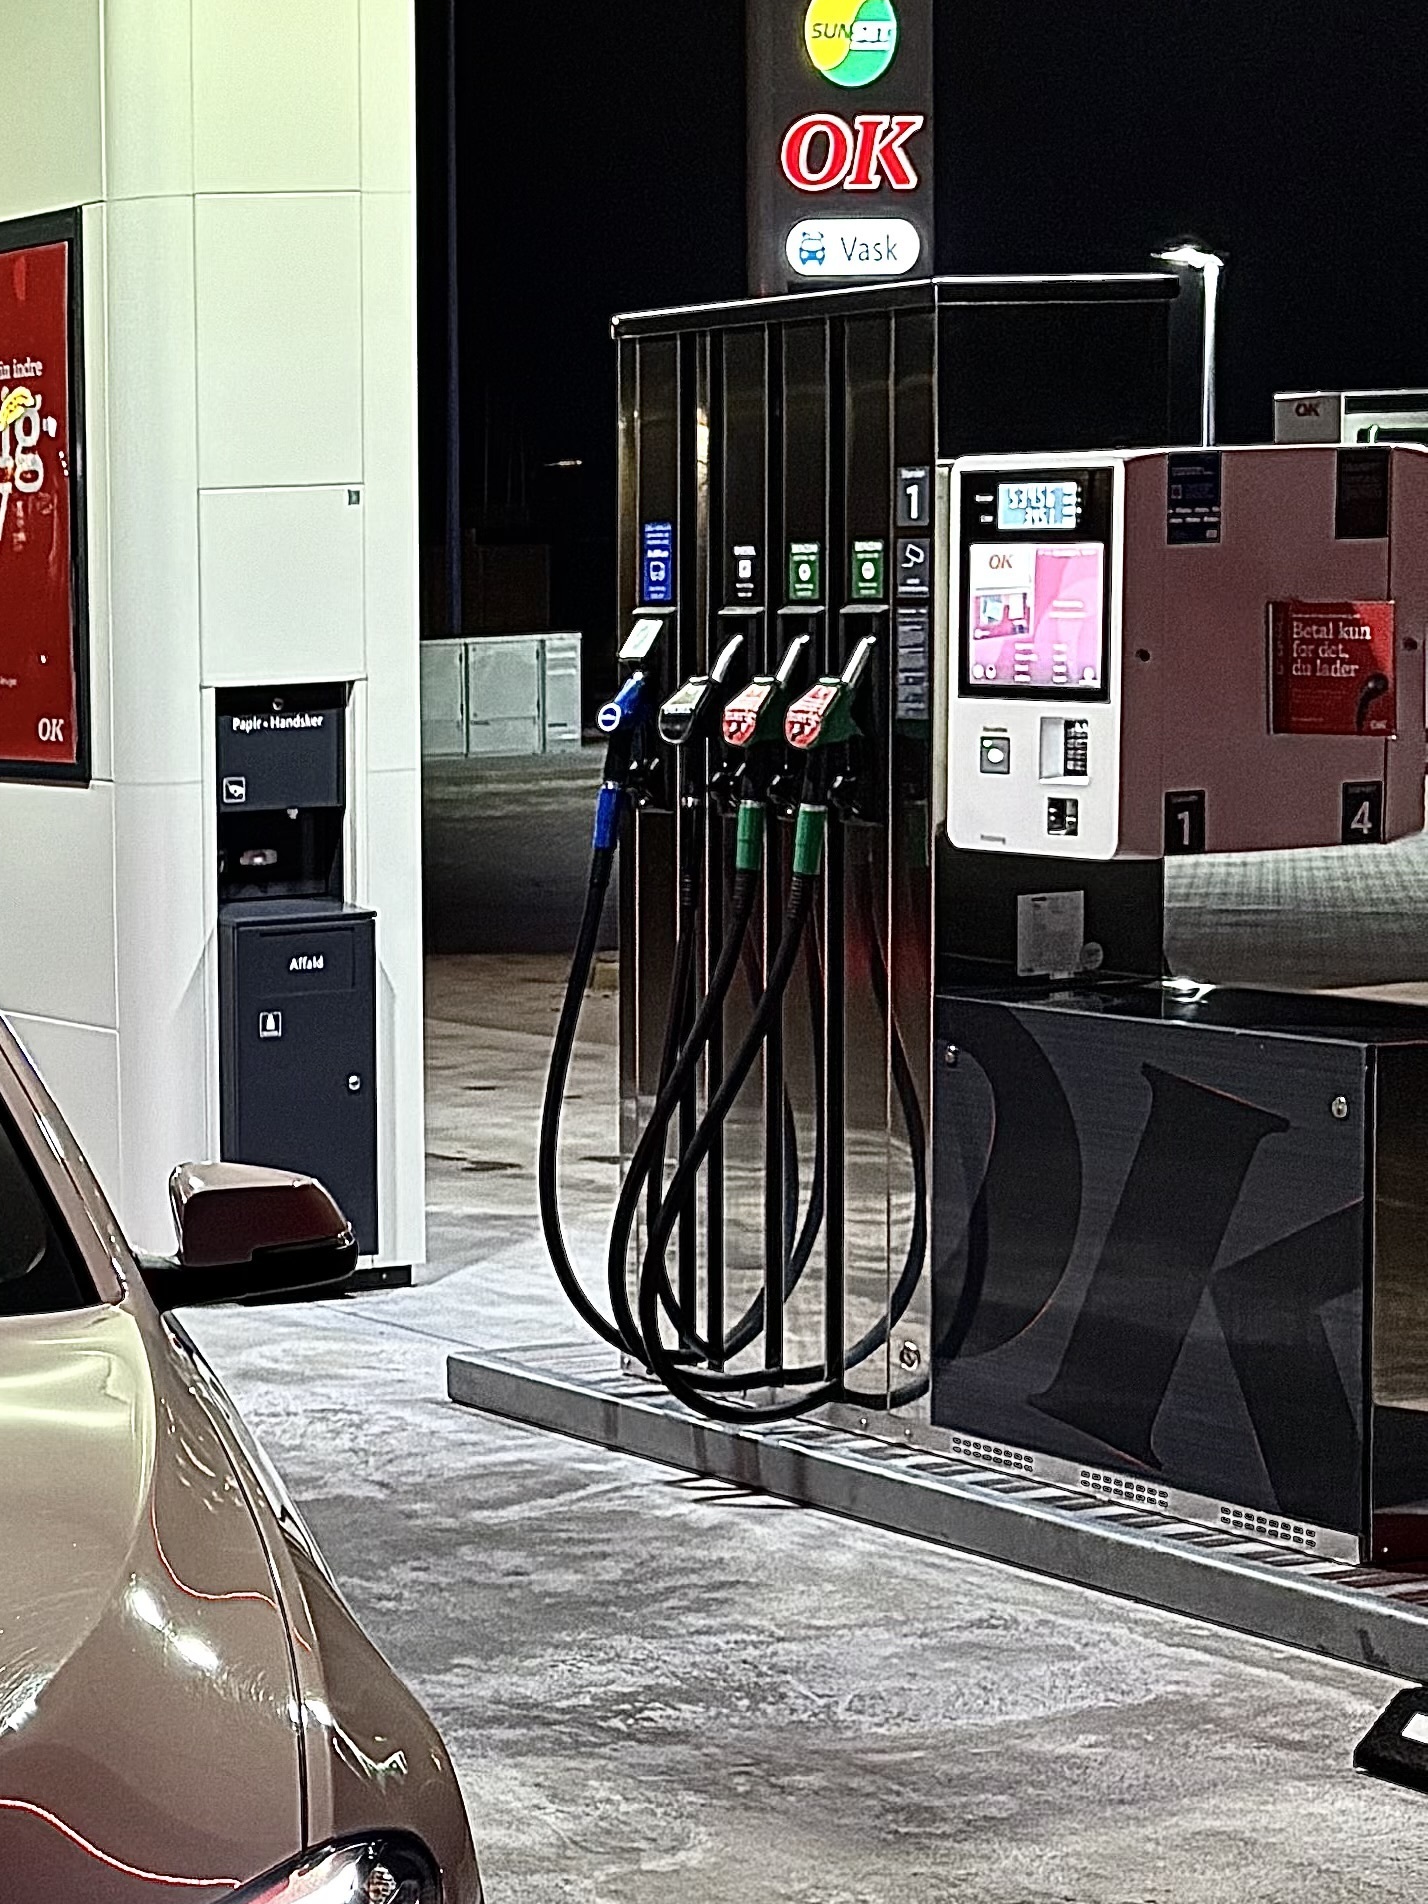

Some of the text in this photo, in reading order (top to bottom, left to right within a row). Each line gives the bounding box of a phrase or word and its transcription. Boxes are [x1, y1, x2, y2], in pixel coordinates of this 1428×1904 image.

[781, 113, 924, 191] OK
[841, 235, 898, 262] Vask
[12, 357, 43, 379] indre
[1294, 403, 1322, 417] OK
[906, 484, 919, 519] 1
[988, 554, 1014, 570] OK
[1292, 620, 1372, 640] Betal kun
[1292, 640, 1315, 658] for
[1292, 658, 1360, 677] du lader
[37, 717, 65, 742] OK
[232, 713, 325, 734] Papir Handsker
[1349, 800, 1374, 835] 4
[1176, 810, 1191, 847] 1
[288, 954, 324, 971] Affald
